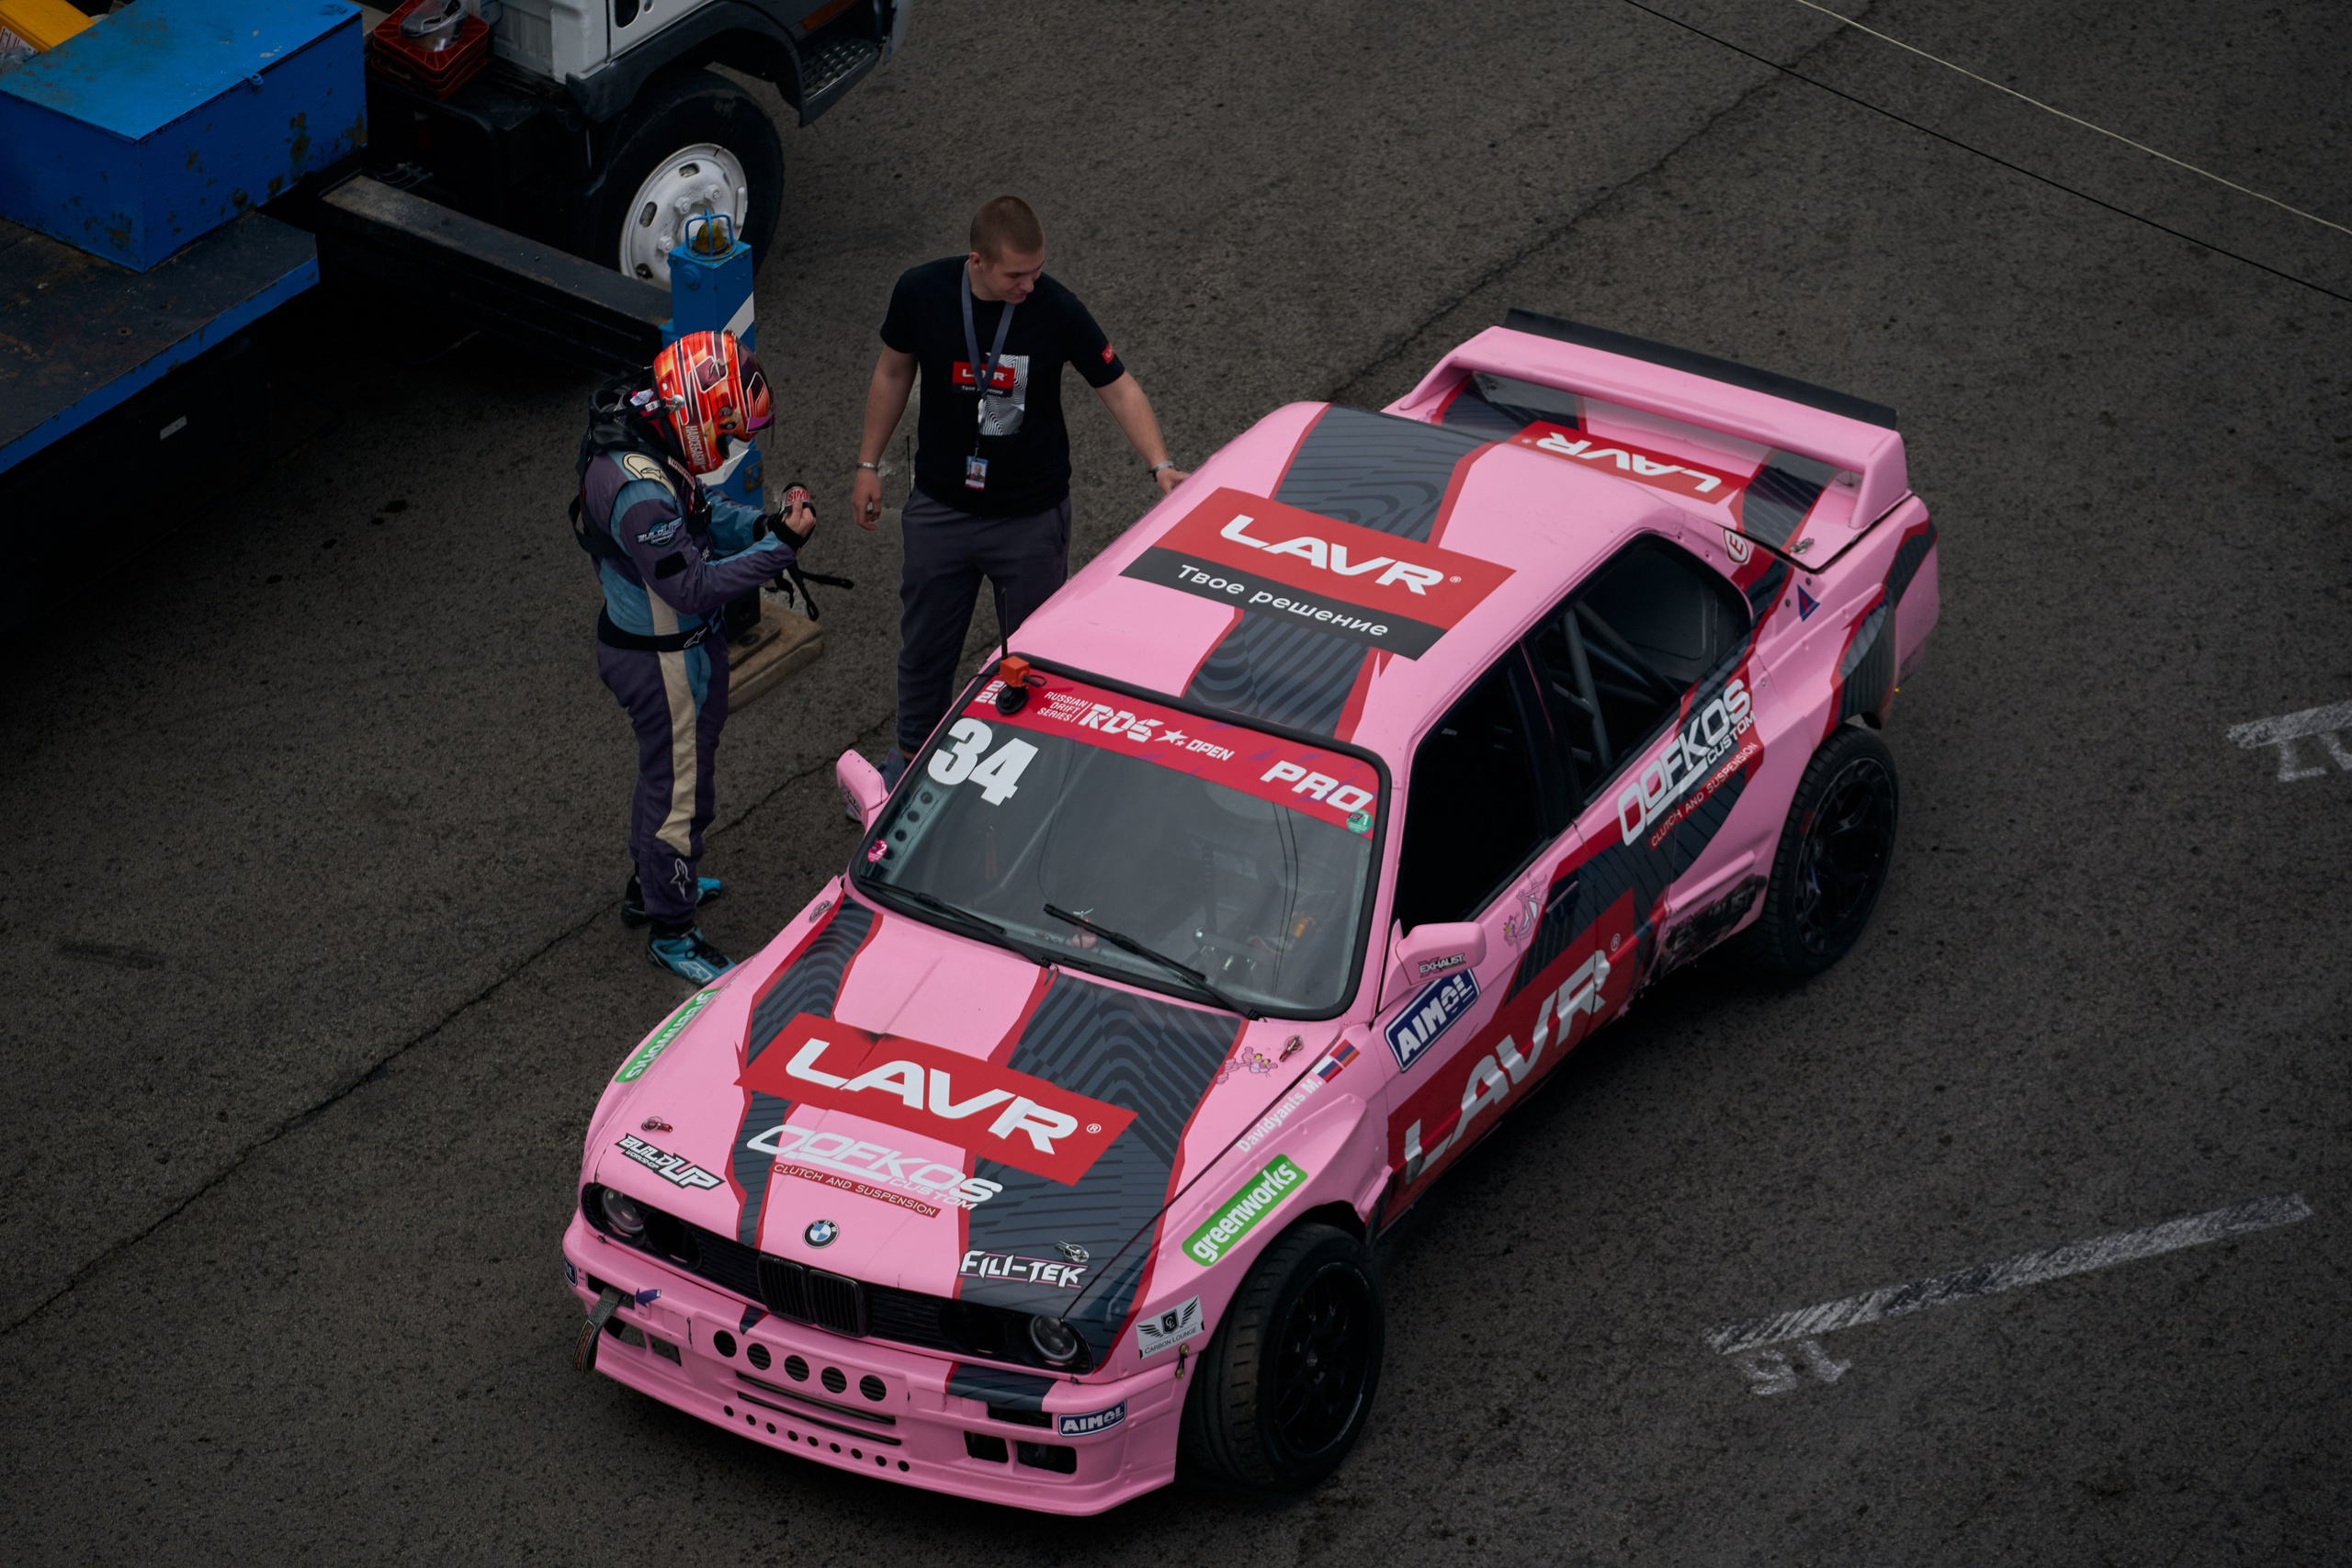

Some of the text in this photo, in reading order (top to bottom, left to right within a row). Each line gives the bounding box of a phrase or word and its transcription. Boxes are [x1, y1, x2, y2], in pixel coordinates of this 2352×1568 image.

[1729, 534, 1744, 556] E
[1178, 564, 1389, 637] Твое решение
[1037, 707, 1073, 721] SERIES
[1045, 692, 1089, 708] RUSSIAN
[1049, 702, 1081, 715] DRIFT
[1078, 704, 1235, 761] RDS OPEN
[1707, 710, 1757, 765] CUSTOM
[928, 717, 1038, 806] 34
[1260, 760, 1373, 813] PRO
[1651, 741, 1758, 847] CLUTCH AND SUSPENSION
[1419, 953, 1464, 974] EXHAUST
[1398, 974, 1474, 1063] AIMOL
[1236, 1077, 1323, 1153] Davidyants M.
[773, 1163, 936, 1216] CLUTCH AND SUSPENSION
[888, 1178, 978, 1211] CUSTOM
[1192, 1161, 1297, 1263] greenworks
[960, 1250, 1087, 1288] FILI-TEK
[1144, 1327, 1198, 1354] CARBON LOUNGE
[1061, 1404, 1126, 1433] AIMOL
